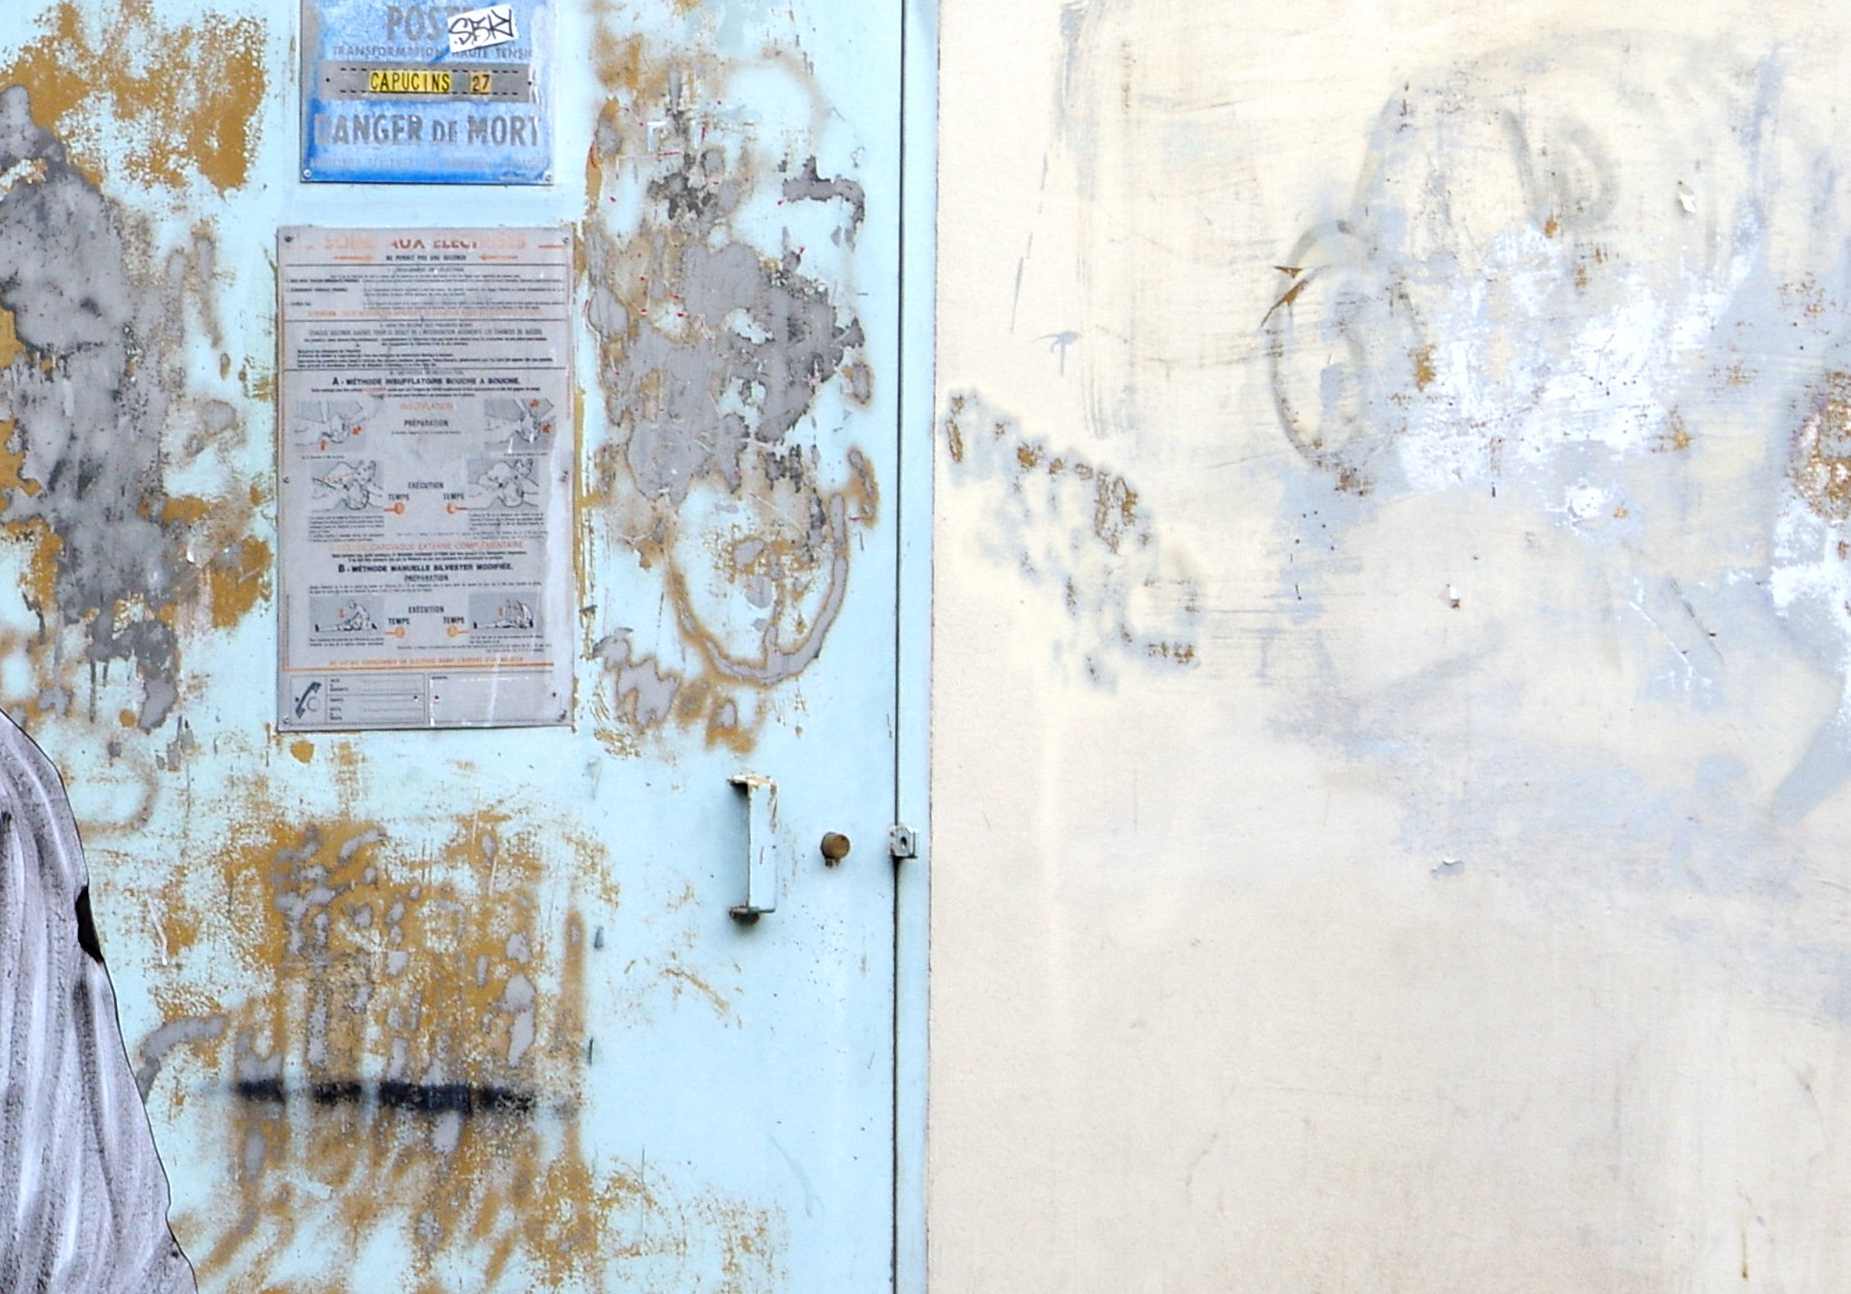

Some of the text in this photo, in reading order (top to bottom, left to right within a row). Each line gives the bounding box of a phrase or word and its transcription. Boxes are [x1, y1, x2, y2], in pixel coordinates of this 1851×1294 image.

[386, 6, 475, 42] POST
[370, 71, 491, 93] CAPUCINS 27
[313, 113, 542, 147] DANGER DE MORT
